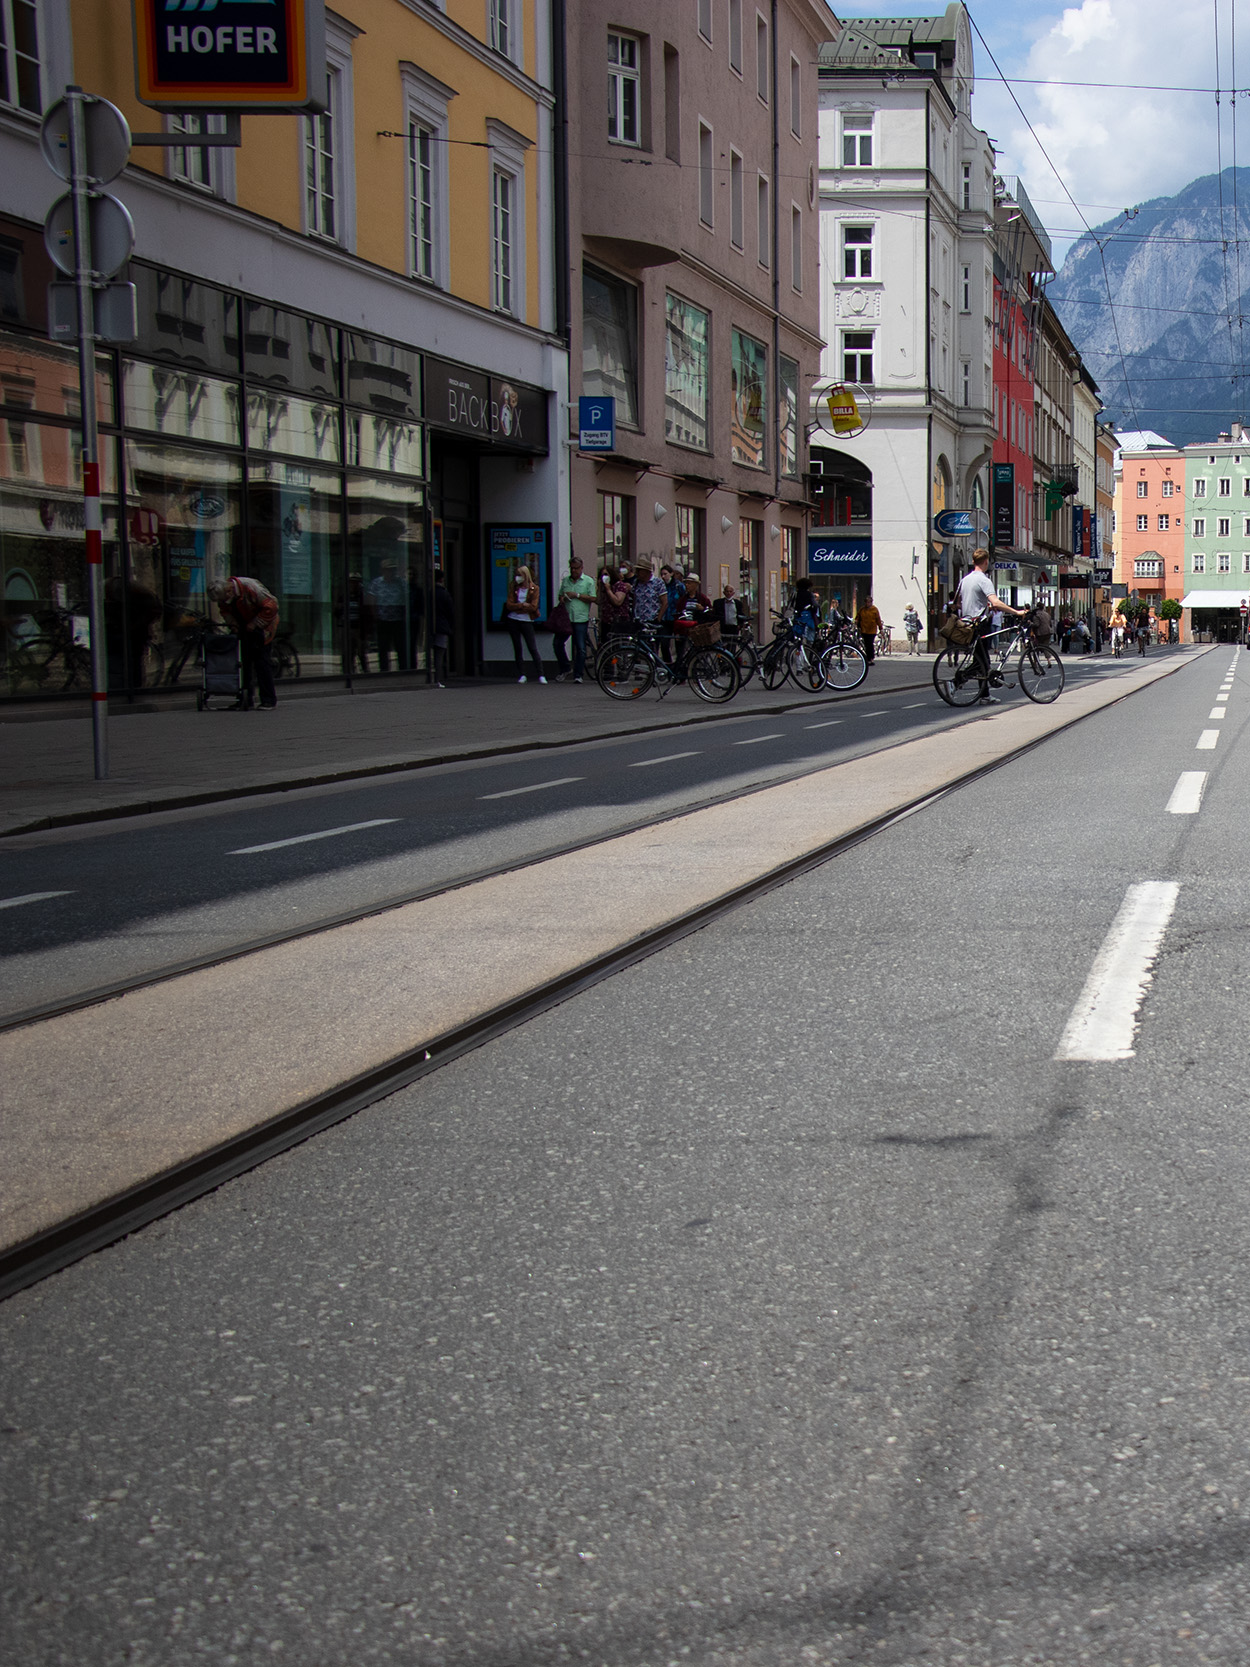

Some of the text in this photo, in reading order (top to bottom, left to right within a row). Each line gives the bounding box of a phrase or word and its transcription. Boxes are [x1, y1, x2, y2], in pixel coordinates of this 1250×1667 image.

[166, 25, 279, 54] HOFER
[592, 409, 602, 425] P
[833, 407, 854, 415] BILLA
[813, 548, 869, 562] Schneider
